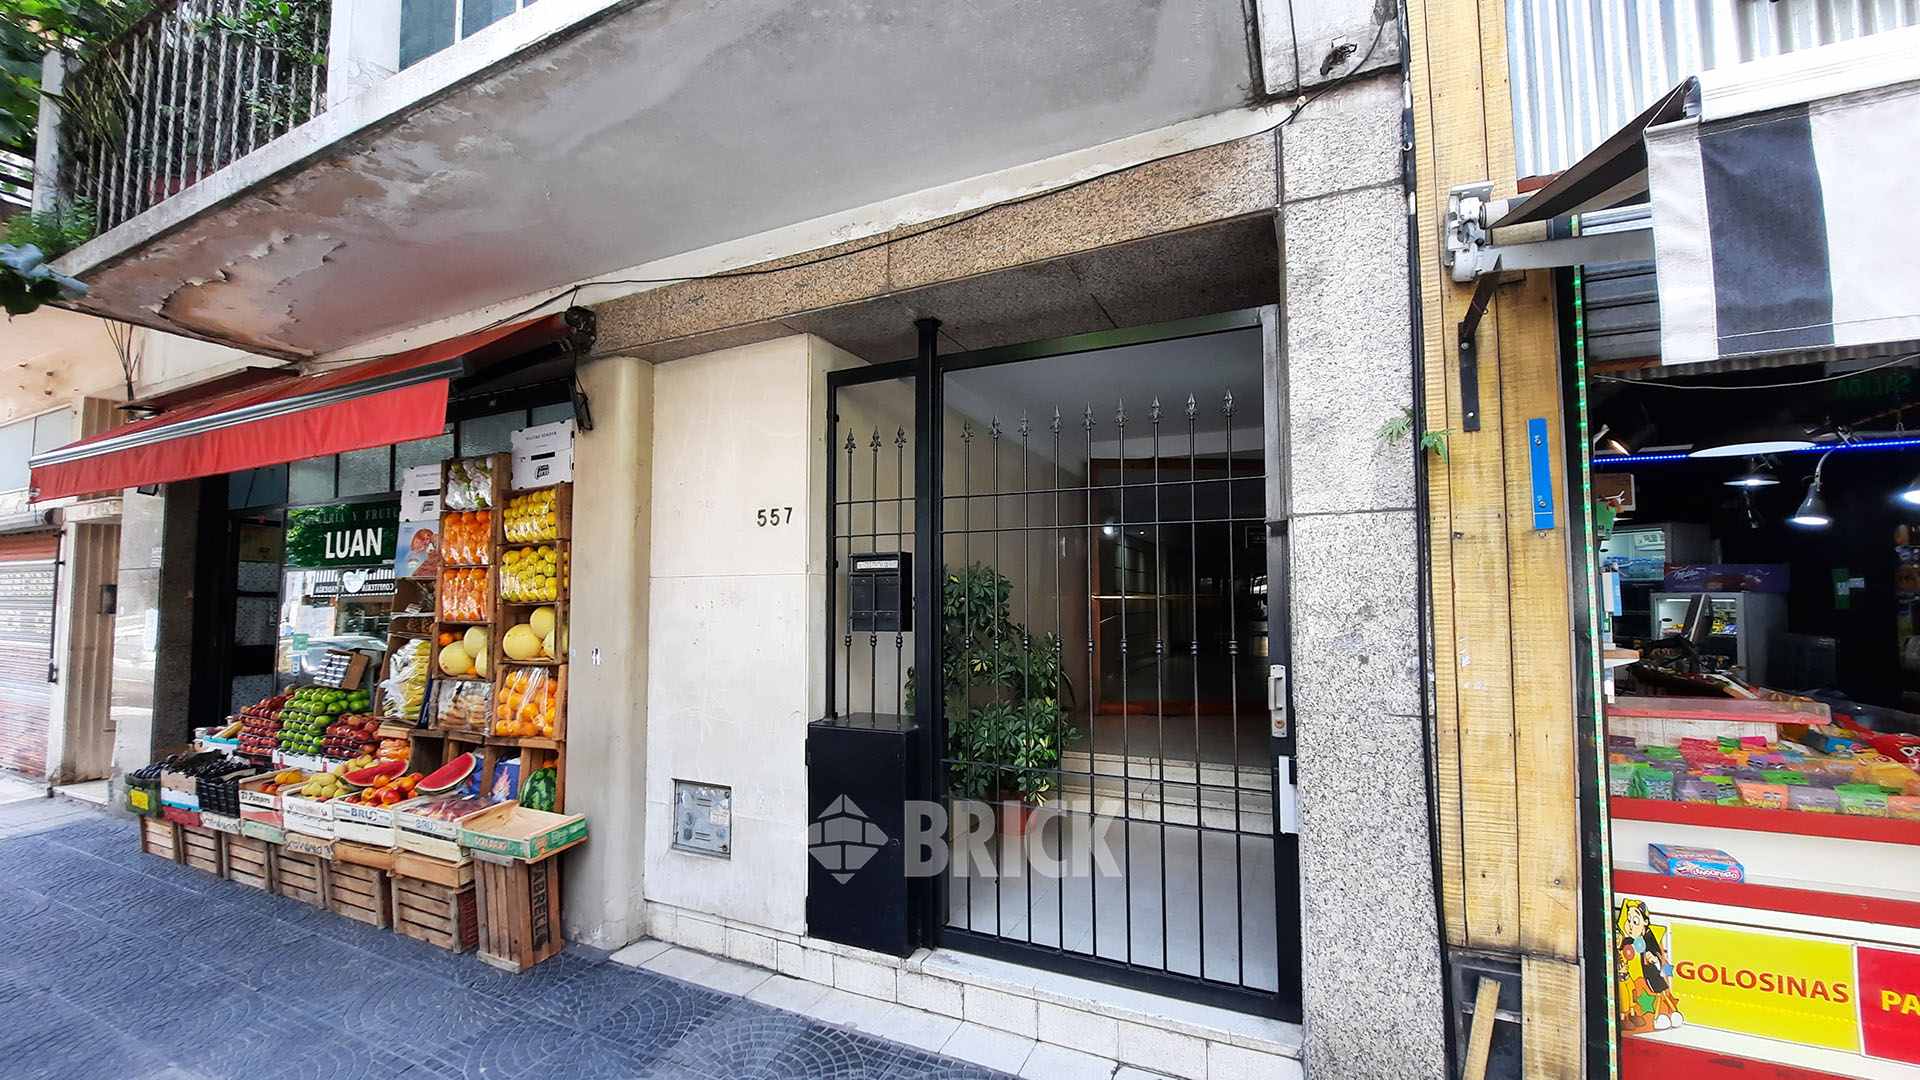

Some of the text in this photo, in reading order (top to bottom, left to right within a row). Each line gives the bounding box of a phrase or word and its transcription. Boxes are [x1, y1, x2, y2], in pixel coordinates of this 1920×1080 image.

[757, 506, 792, 527] 557
[324, 527, 383, 559] LUAN
[1676, 961, 1850, 1003] GOLOSINAS
